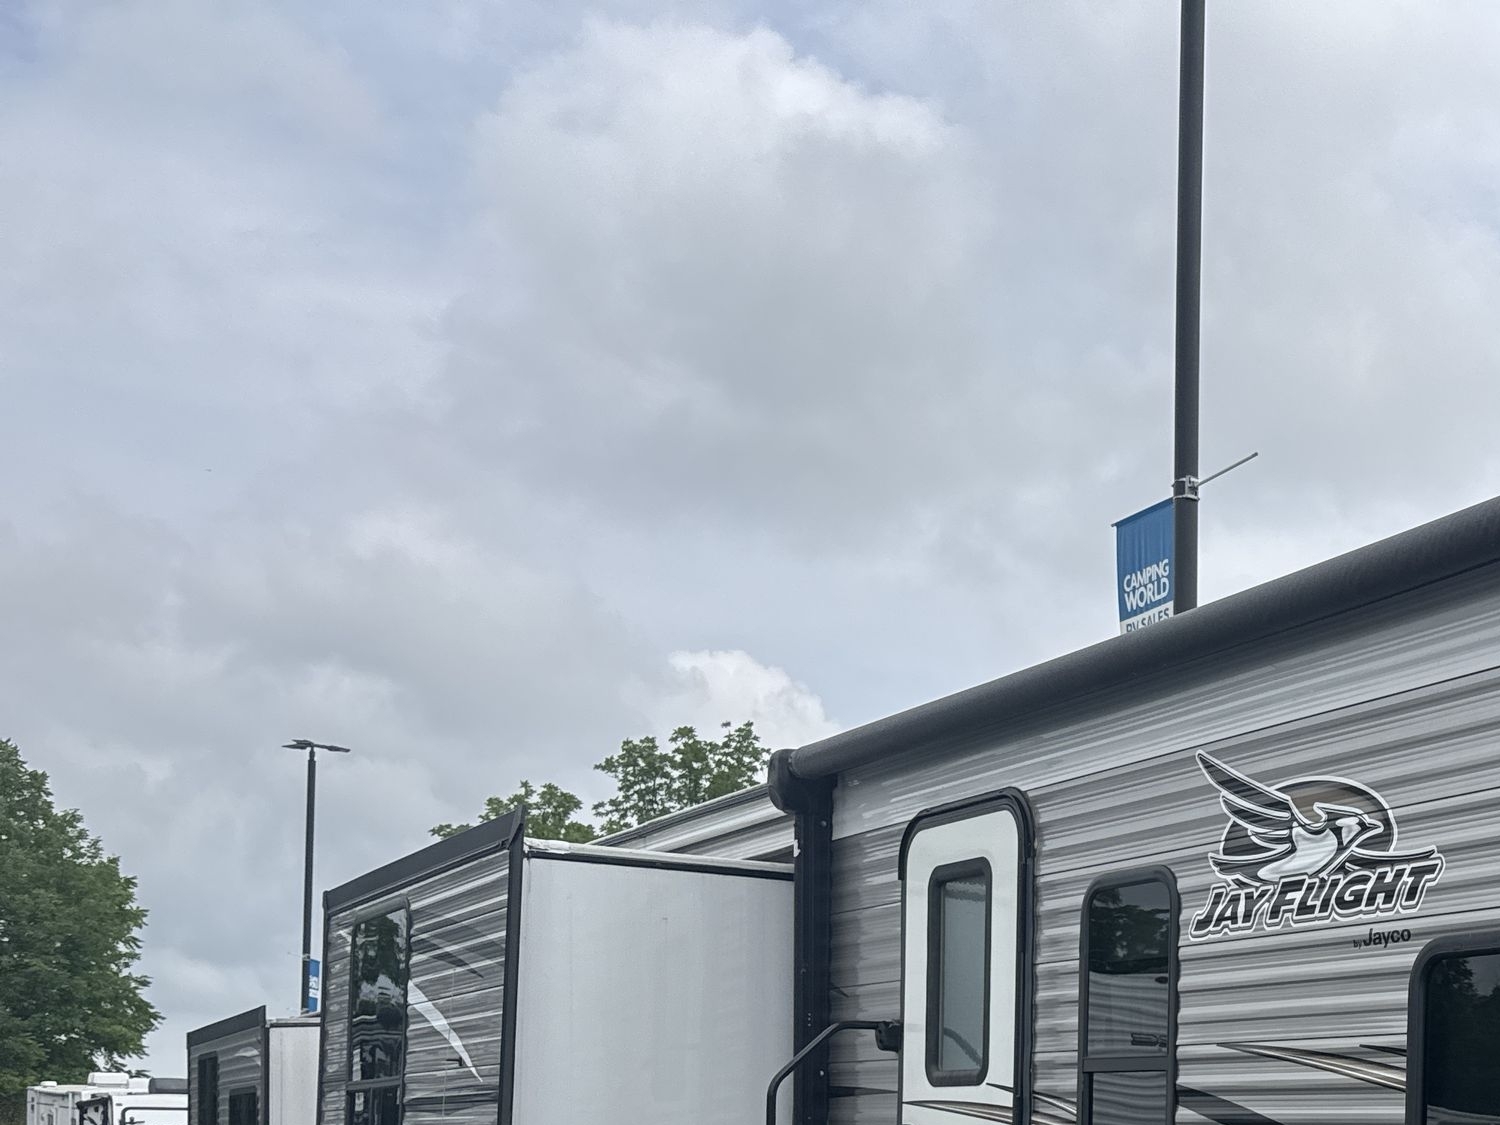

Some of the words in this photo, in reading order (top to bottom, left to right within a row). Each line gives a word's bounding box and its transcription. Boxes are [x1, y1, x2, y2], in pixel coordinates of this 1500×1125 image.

[1124, 559, 1169, 592] CAMPING
[1124, 577, 1169, 612] WORLD
[1190, 884, 1275, 939] JAY
[1264, 856, 1445, 929] FLIGHT
[1363, 928, 1411, 948] Jayco
